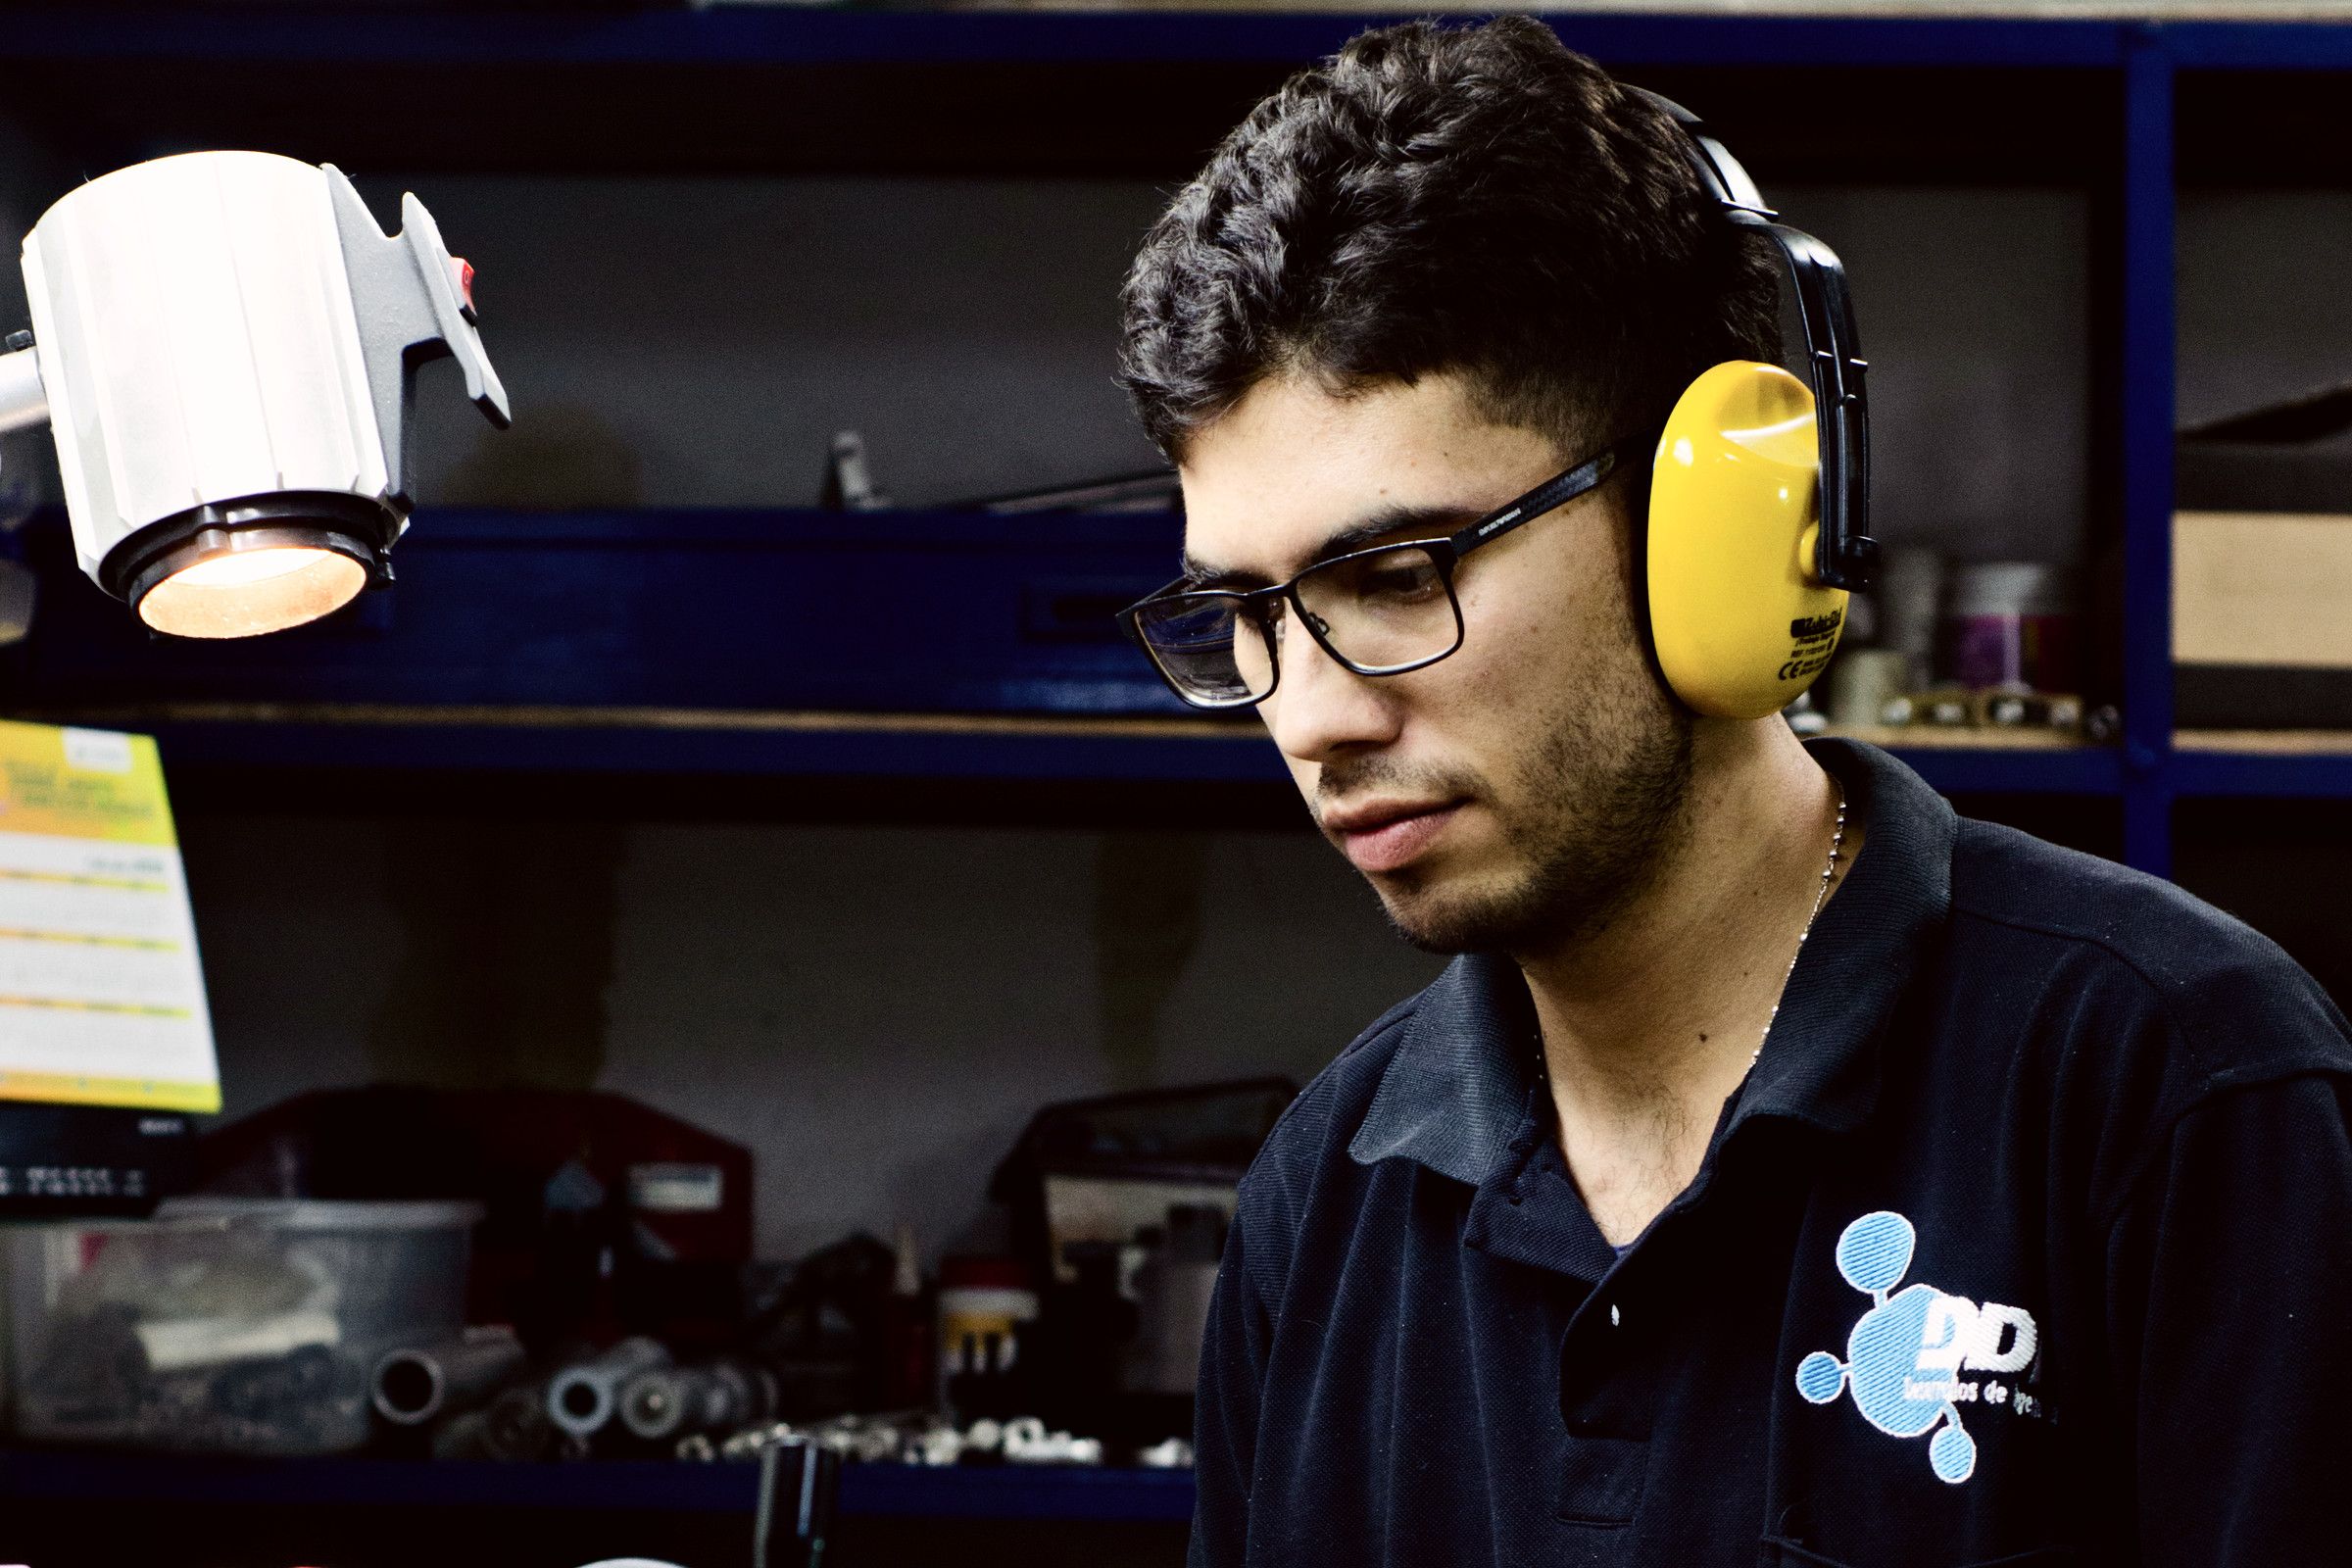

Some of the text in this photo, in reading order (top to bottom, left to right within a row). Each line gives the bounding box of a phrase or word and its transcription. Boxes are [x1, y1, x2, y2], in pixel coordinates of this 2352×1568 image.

[1778, 660, 1803, 681] CE
[1916, 1296, 2040, 1383] DD
[1983, 1380, 2009, 1405] de
